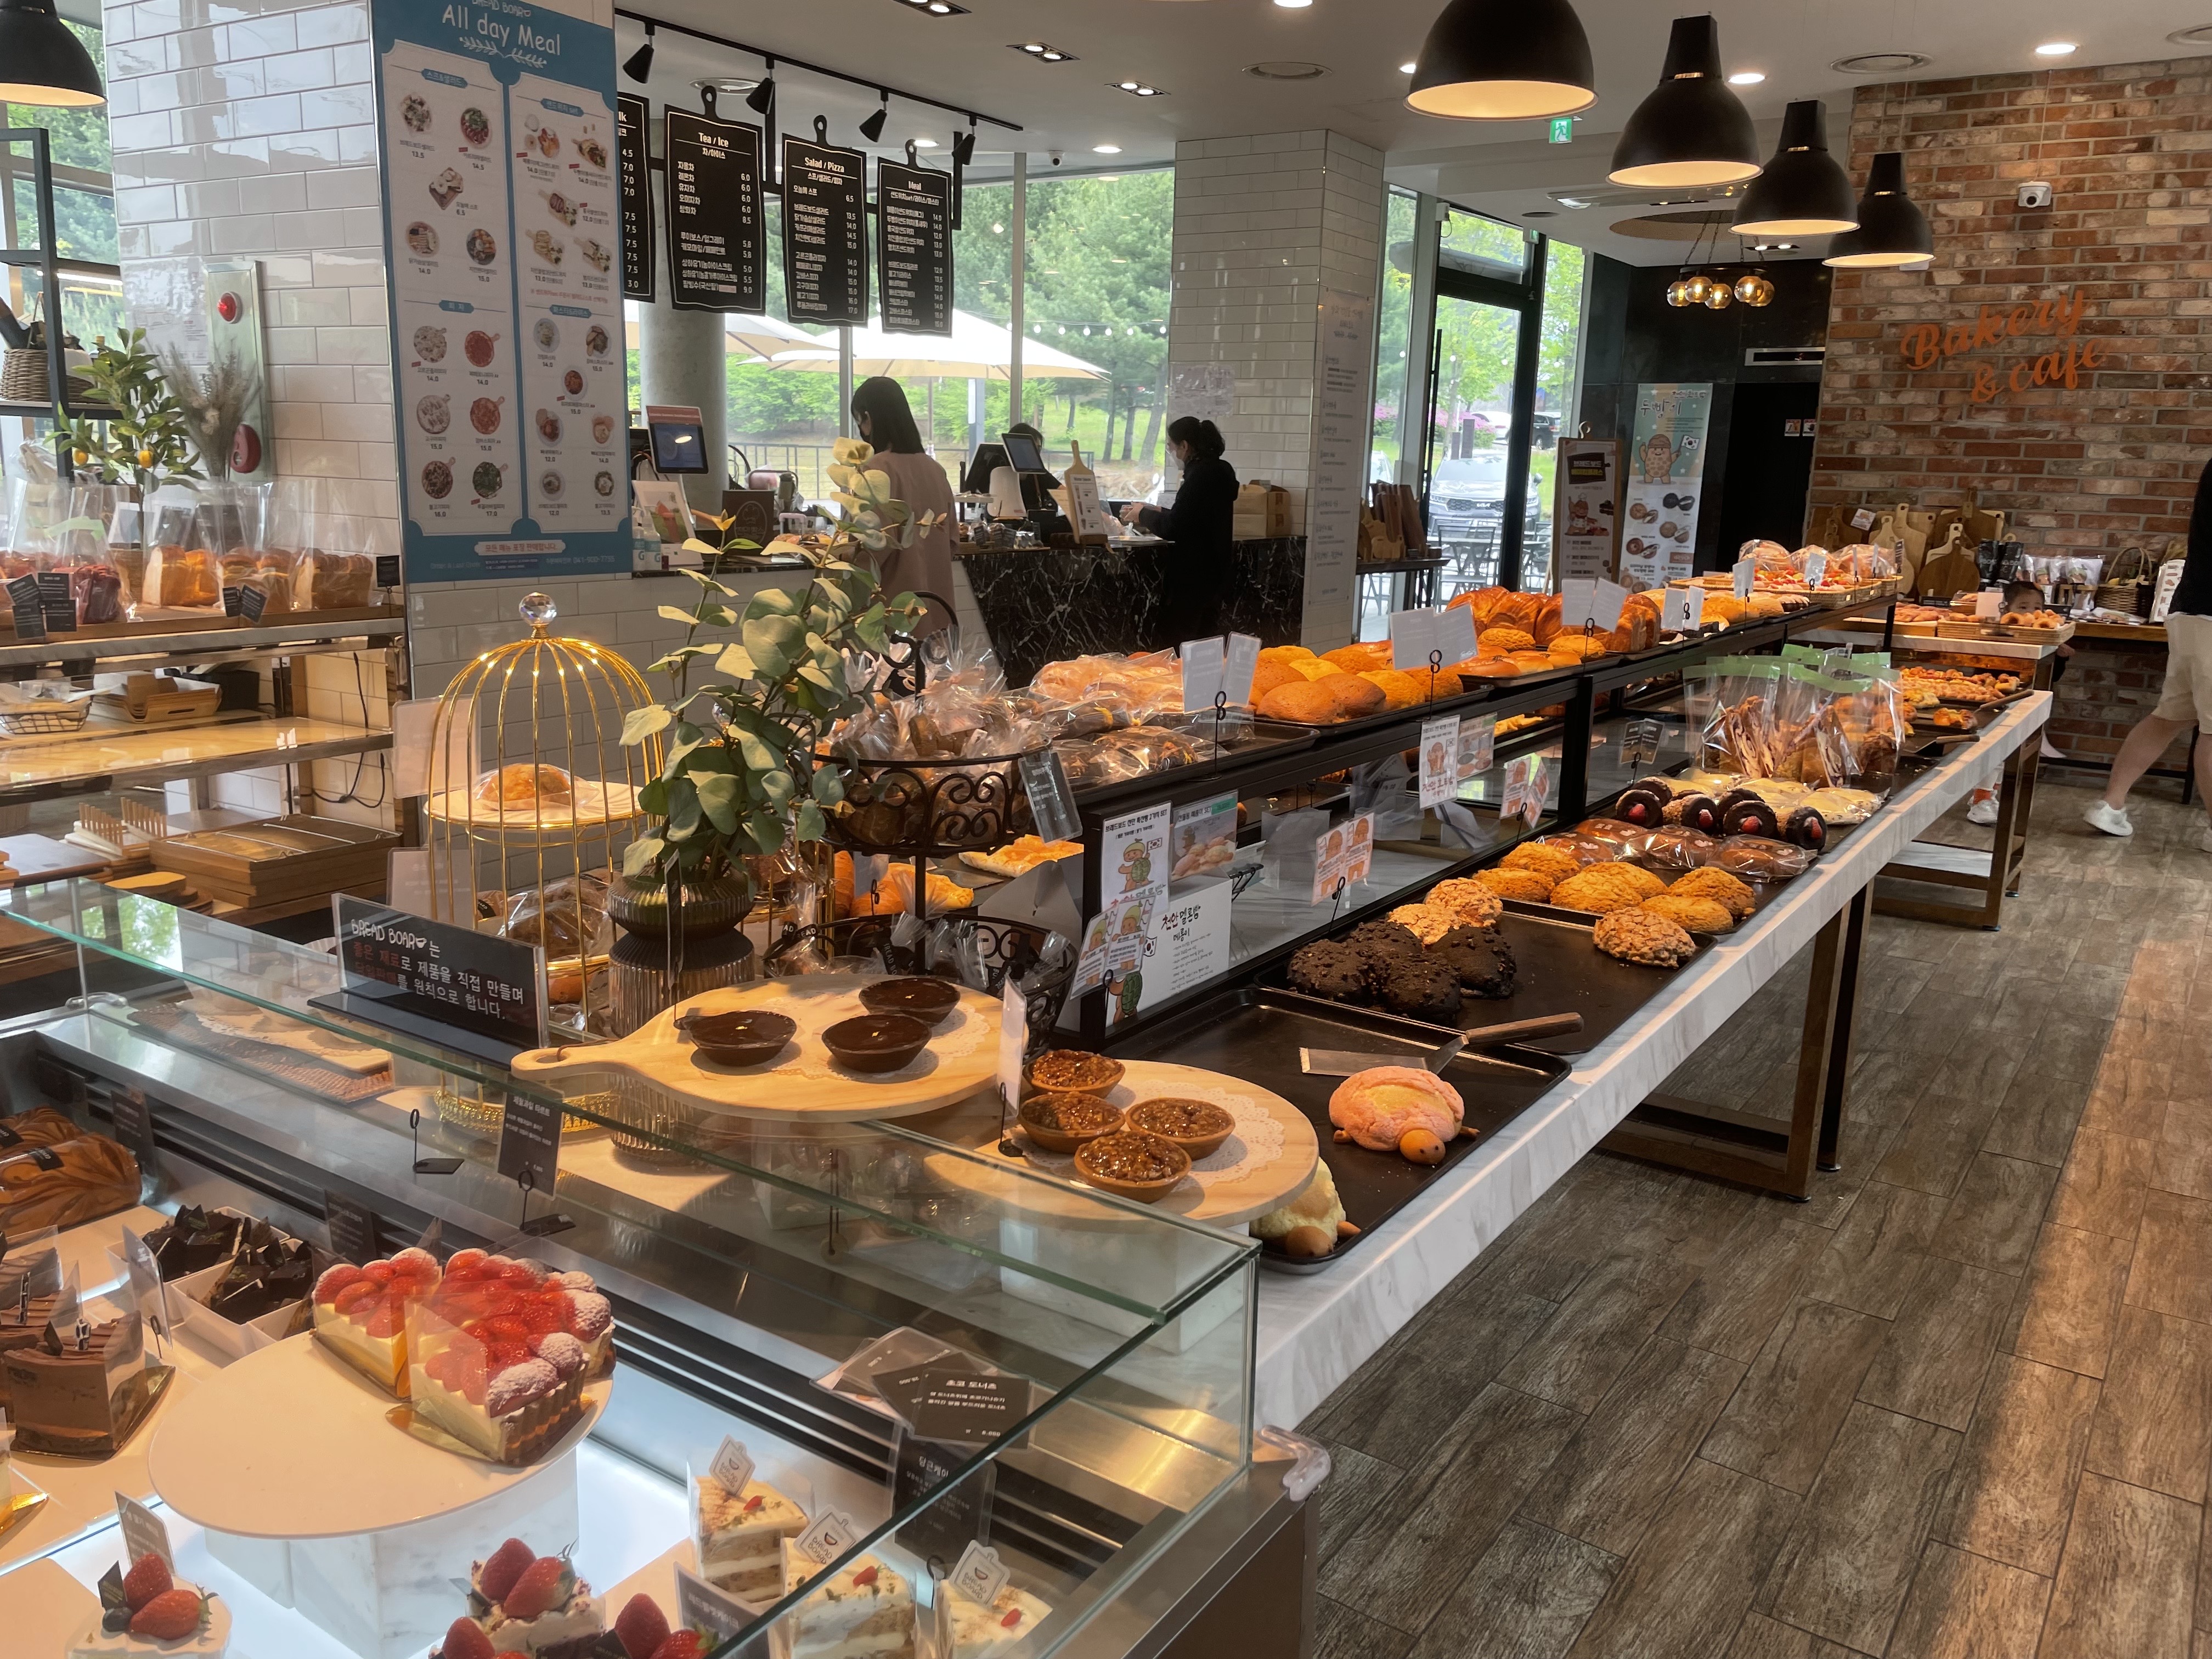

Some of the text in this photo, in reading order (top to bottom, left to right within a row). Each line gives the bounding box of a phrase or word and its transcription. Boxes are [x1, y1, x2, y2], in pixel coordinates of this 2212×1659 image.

[442, 4, 560, 55] All day Meal
[698, 132, 711, 144] Tea
[718, 137, 729, 148] Ice
[622, 149, 633, 157] 4.5
[623, 162, 634, 171] 7.0
[805, 157, 822, 168] Salad
[827, 161, 844, 173] Pizza
[624, 176, 634, 184] 7.0
[624, 188, 635, 196] 7.0
[679, 183, 695, 193] 유자차
[741, 184, 751, 192] 6.0
[679, 194, 701, 205] 오미자차
[742, 194, 751, 202] 6.0
[742, 205, 751, 213] 6.0
[625, 212, 636, 221] 7.5
[847, 212, 856, 220] 13.5
[625, 225, 636, 234] 7.5
[847, 232, 856, 240] 14.5
[626, 239, 637, 248] 7.5
[627, 252, 637, 261] 7.5
[627, 265, 638, 274] 7.5
[628, 280, 639, 289] 3.0
[1900, 289, 2091, 370] Bakery
[1971, 337, 2108, 403] & cafe
[1161, 911, 1179, 930] 천안
[351, 919, 385, 941] BREAD
[429, 940, 441, 958] 는
[353, 941, 524, 1005] 좋은 재료로 제품을 직접 만들며
[414, 978, 460, 1005] 원칙으로
[465, 993, 506, 1019] 합니다.
[919, 1455, 949, 1477] 당근케이
[812, 1536, 833, 1559] BREAD
[808, 1543, 827, 1565] BOARD
